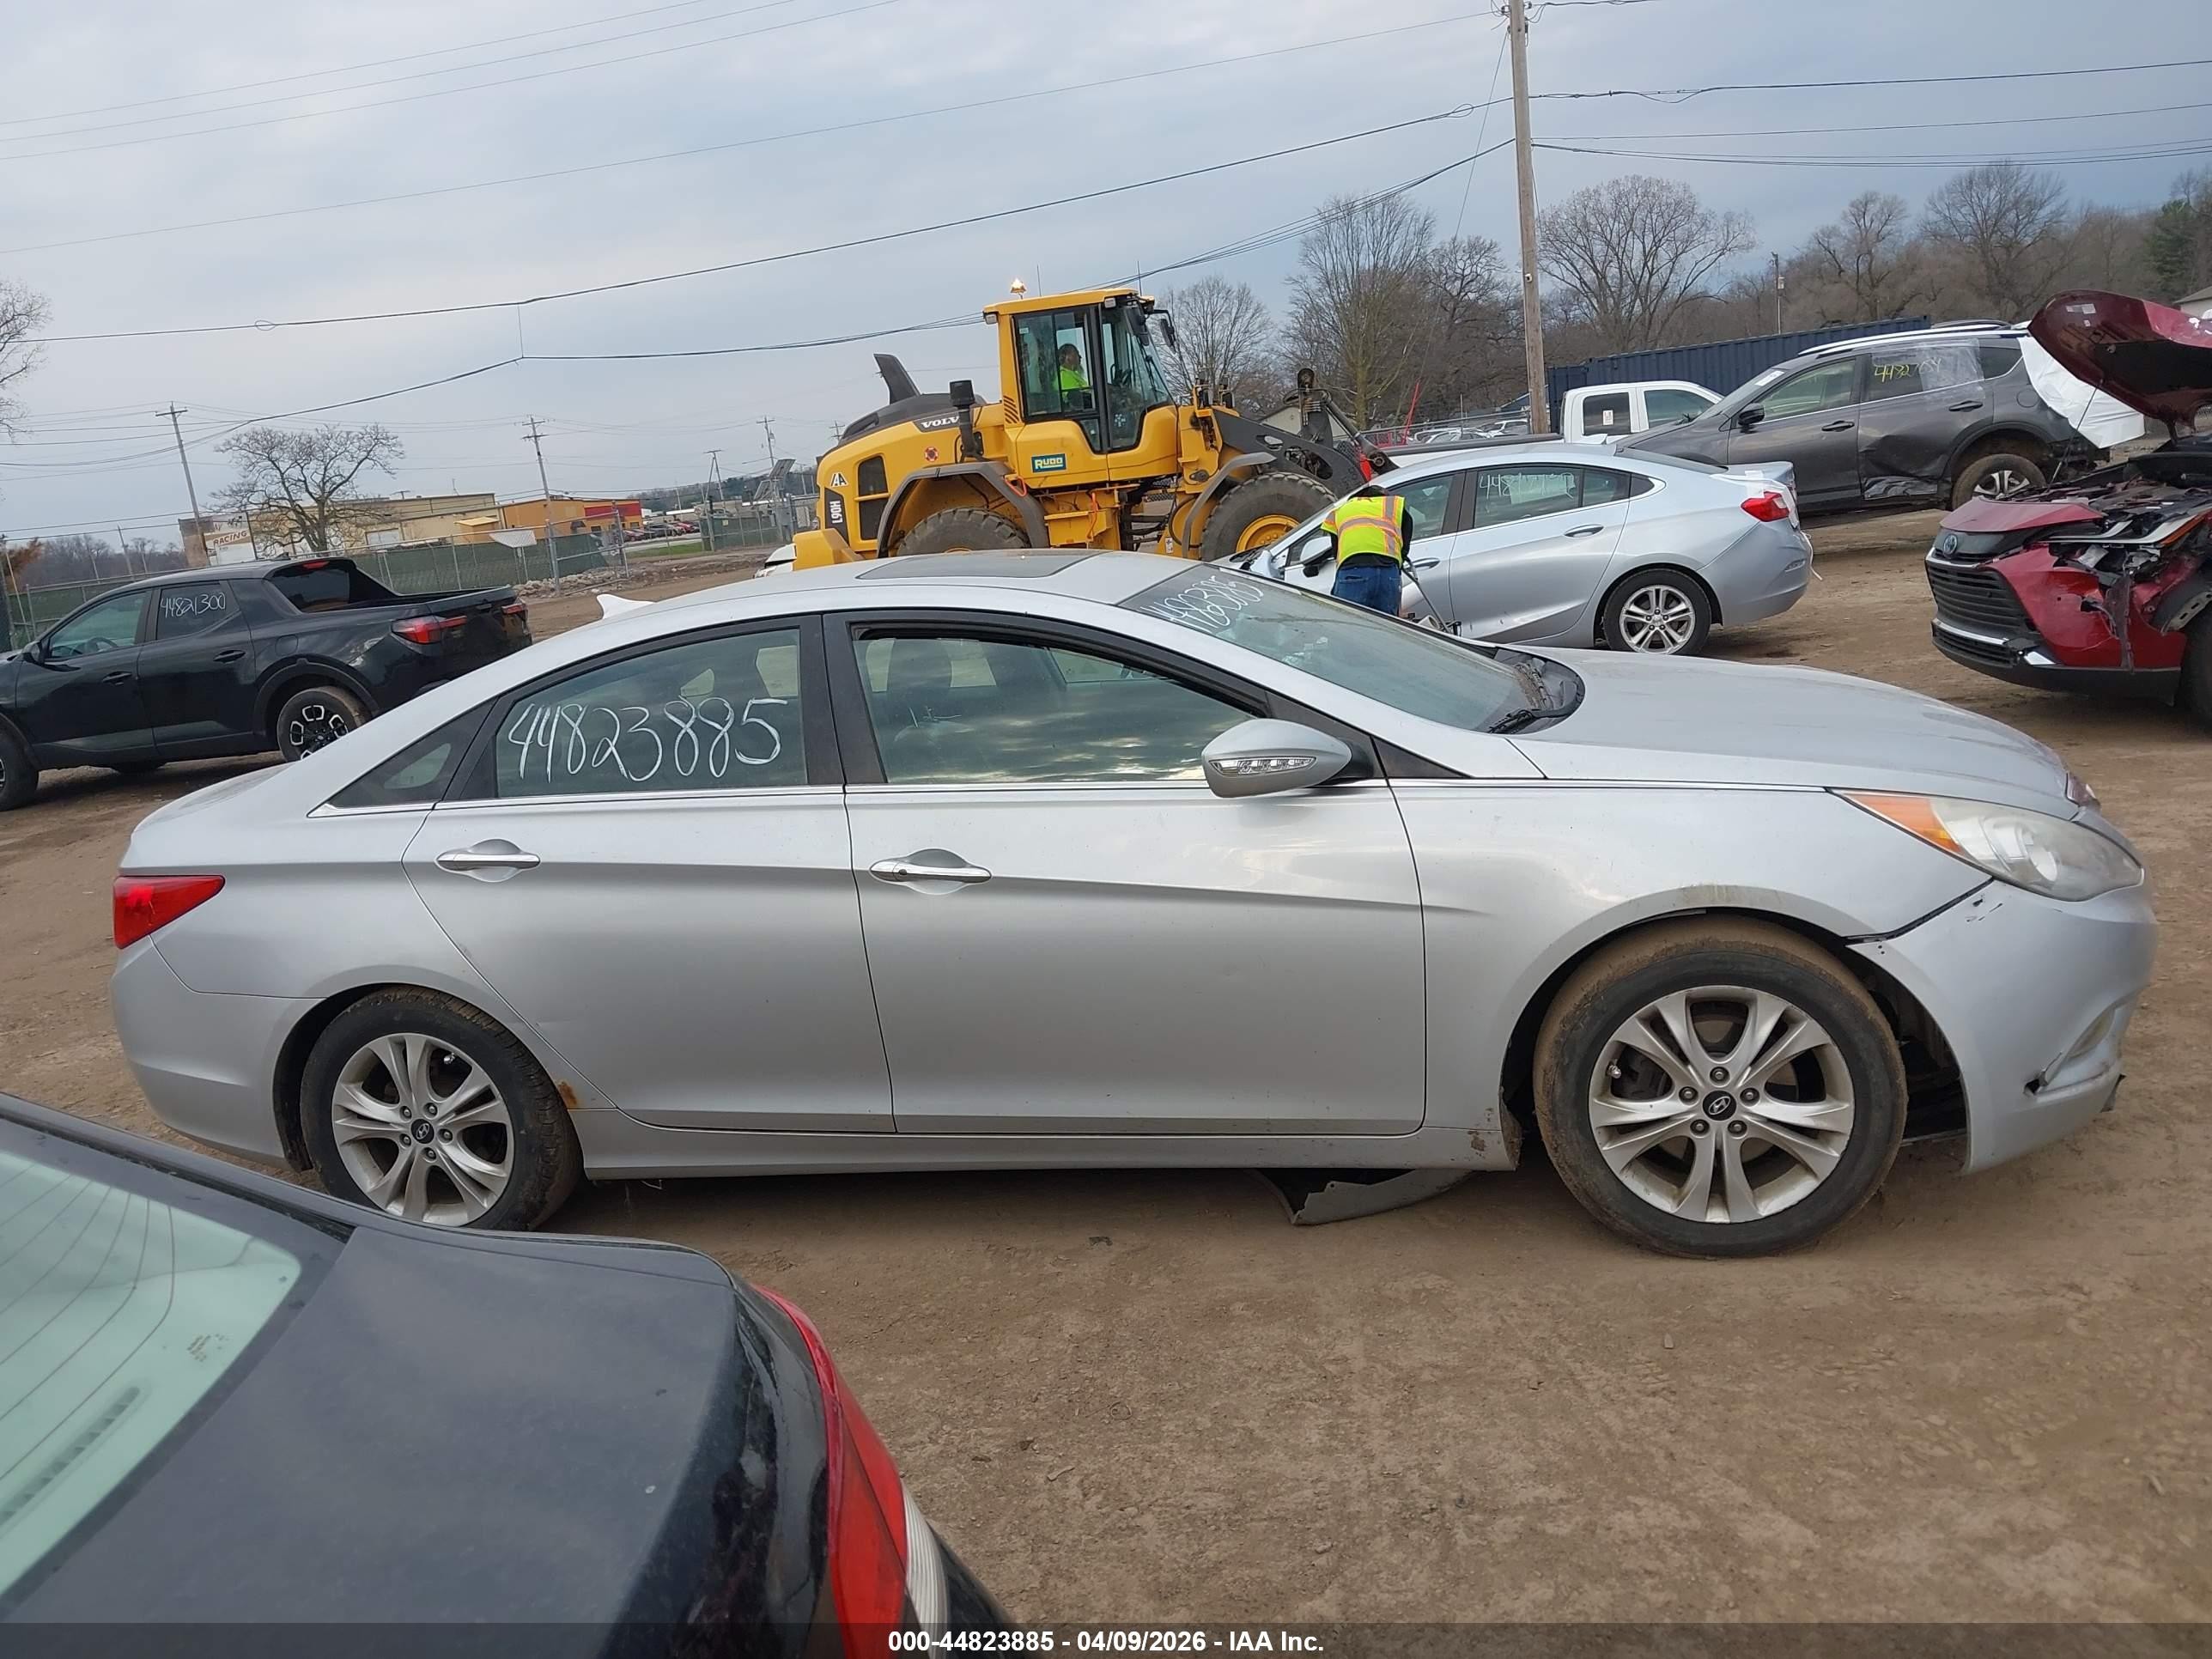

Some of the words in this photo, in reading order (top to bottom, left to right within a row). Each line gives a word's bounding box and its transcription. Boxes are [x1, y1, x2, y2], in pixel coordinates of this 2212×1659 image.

[921, 416, 960, 428] VOLV
[829, 500, 844, 524] L90H
[213, 530, 248, 545] RACING
[160, 592, 226, 618] 44821300
[507, 696, 788, 783] 44823885
